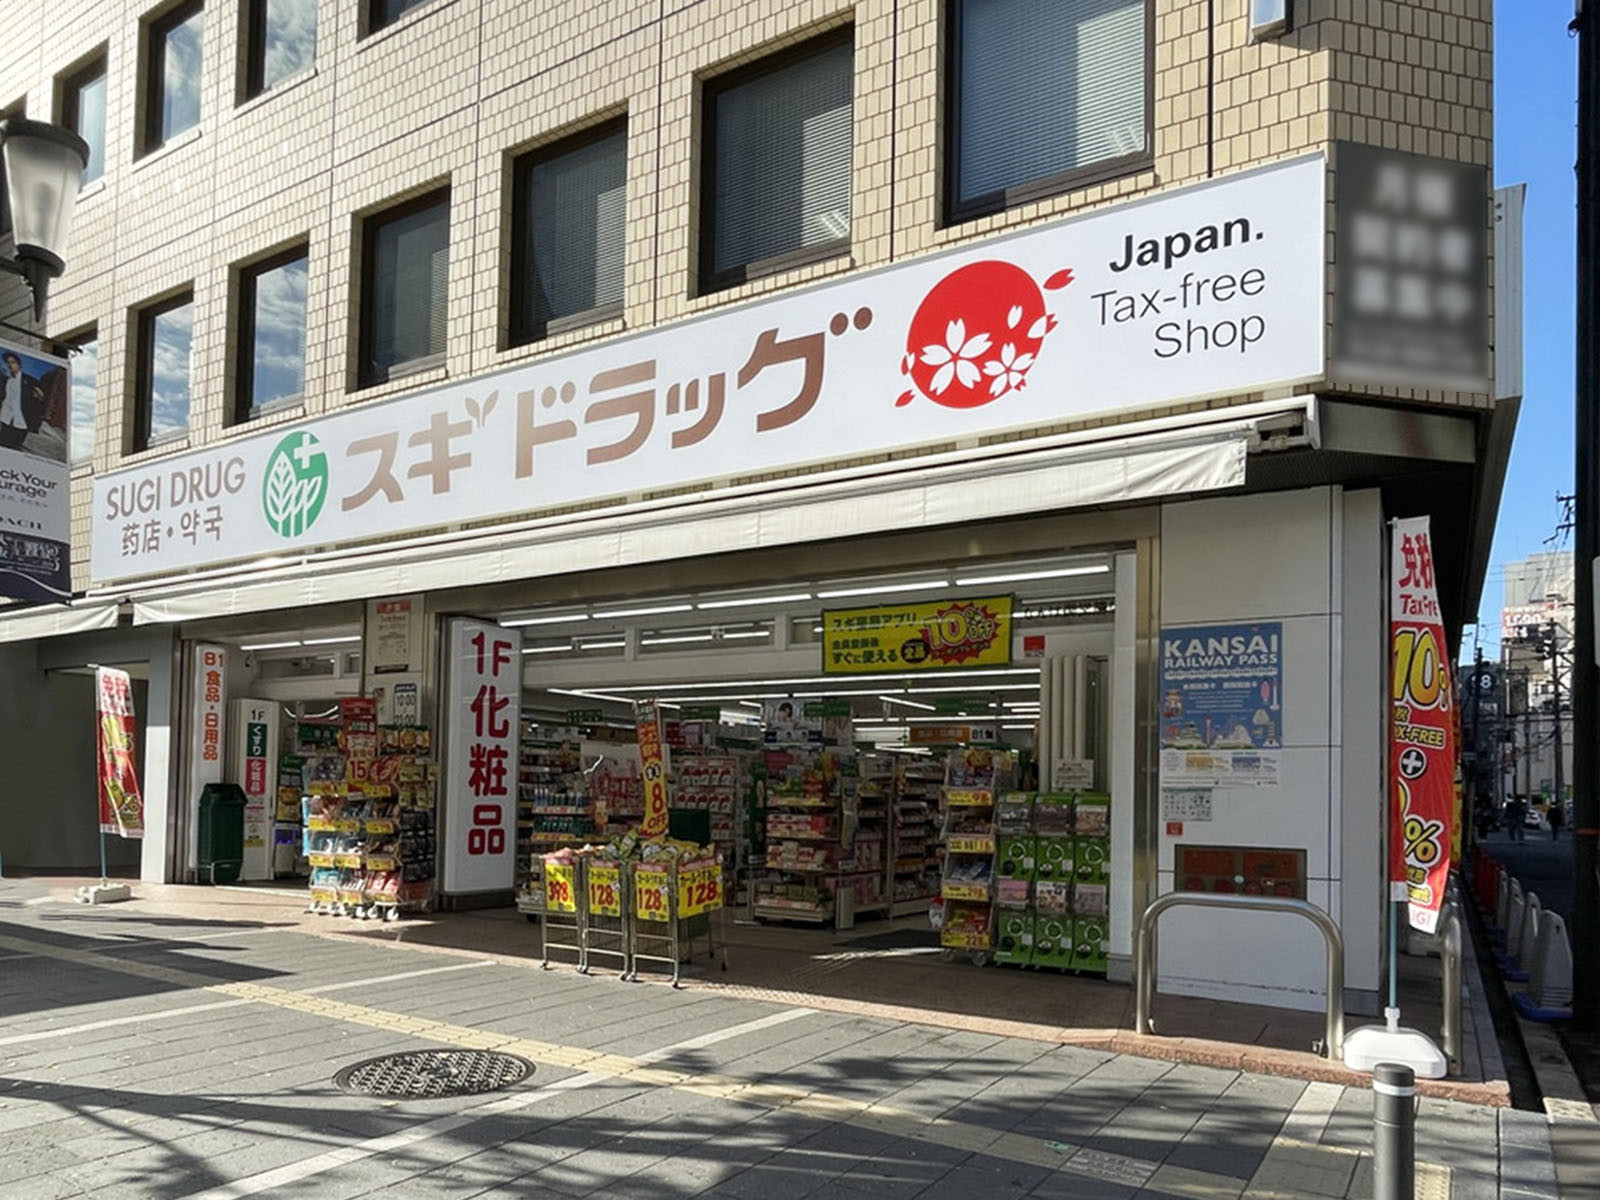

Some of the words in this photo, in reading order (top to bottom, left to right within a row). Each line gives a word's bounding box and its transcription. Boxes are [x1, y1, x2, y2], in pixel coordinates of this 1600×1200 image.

[1109, 217, 1264, 273] Japan.
[1090, 268, 1266, 326] Tax-free
[1154, 314, 1265, 358] Shop
[21, 471, 58, 489] Your
[106, 476, 161, 521] SUGI
[170, 457, 246, 508] DRUG
[204, 651, 224, 668] B1
[471, 631, 513, 677] 1F
[1164, 634, 1279, 658] KANSAI
[1164, 655, 1234, 669] RAILWAY
[1238, 653, 1278, 665] PASS
[250, 709, 265, 722] 1F
[252, 725, 262, 756] くすり
[468, 684, 510, 856] 化粧品
[591, 883, 614, 906] 128
[638, 887, 662, 911] 128
[686, 881, 718, 908] 128
